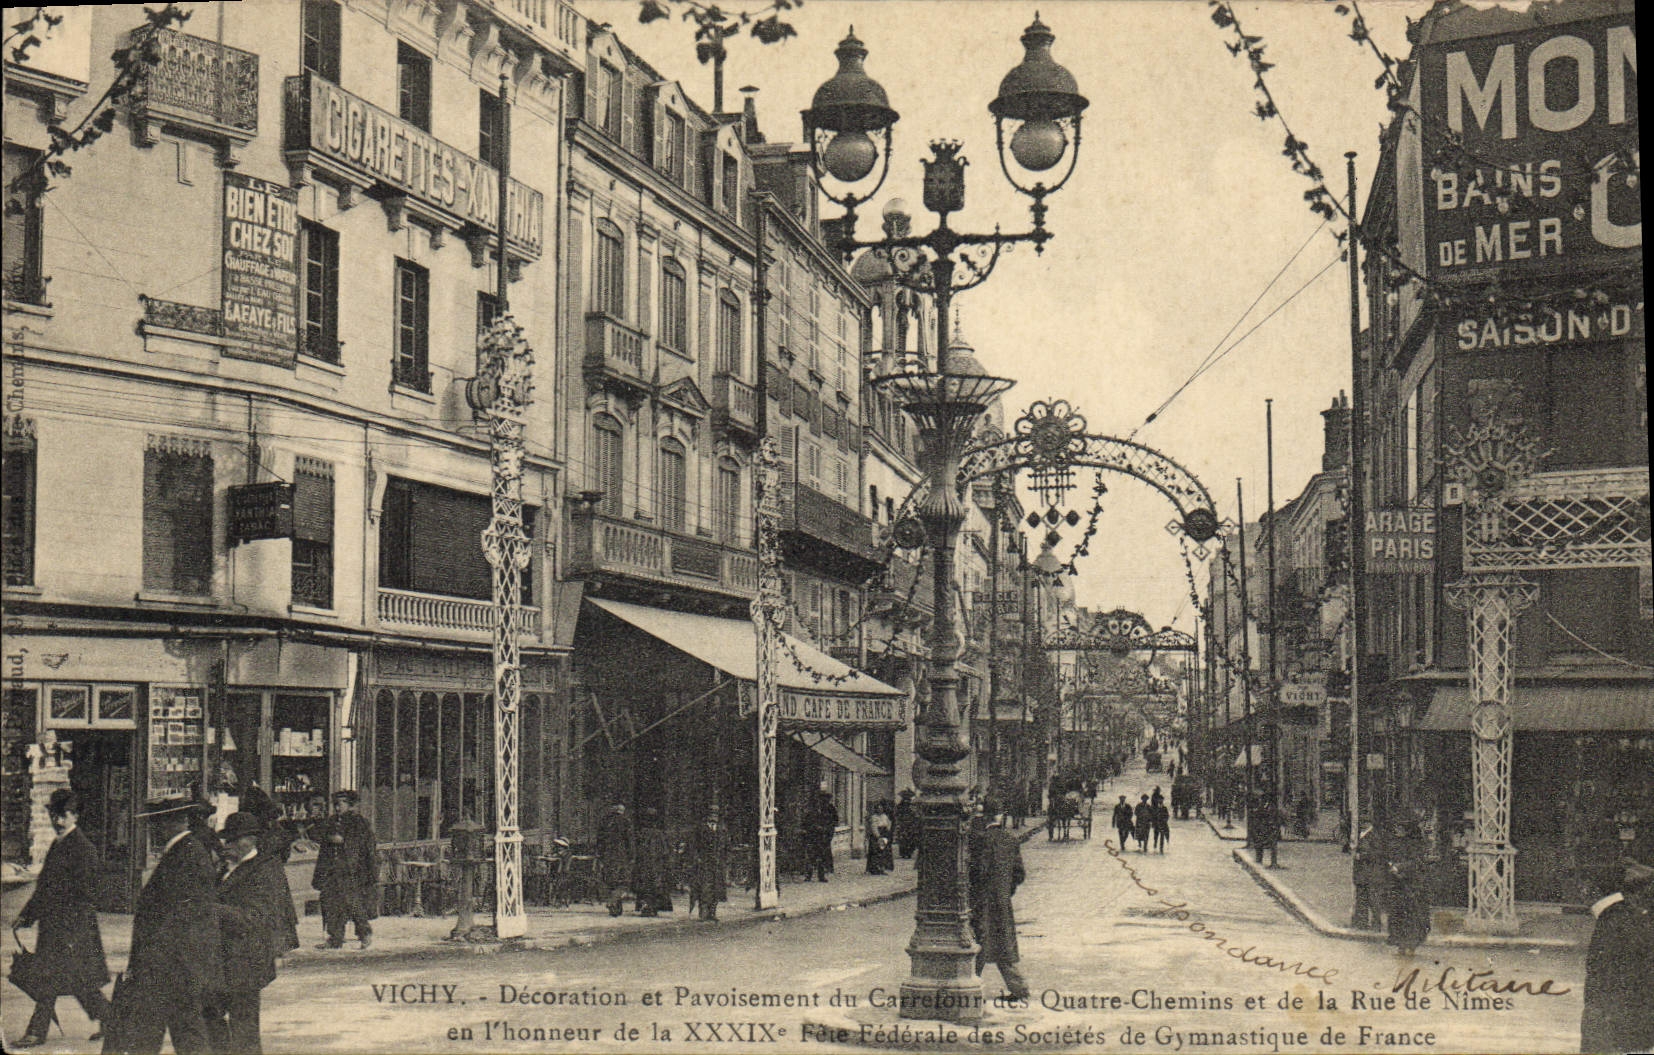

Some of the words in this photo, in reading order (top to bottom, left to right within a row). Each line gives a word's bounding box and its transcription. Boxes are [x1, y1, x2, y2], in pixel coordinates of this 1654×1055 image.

[226, 185, 265, 226] BIEN
[247, 178, 281, 196] LE
[1437, 159, 1562, 211] BAINS
[230, 220, 272, 257] CHEZ
[273, 231, 294, 264] SOI
[1439, 239, 1467, 266] DE
[1475, 217, 1563, 264] MER
[1457, 309, 1590, 351] SAISON
[1365, 511, 1437, 533] ARAGE
[1371, 538, 1434, 559] PARIS
[836, 700, 850, 720] DE
[855, 700, 893, 720] FRANCE
